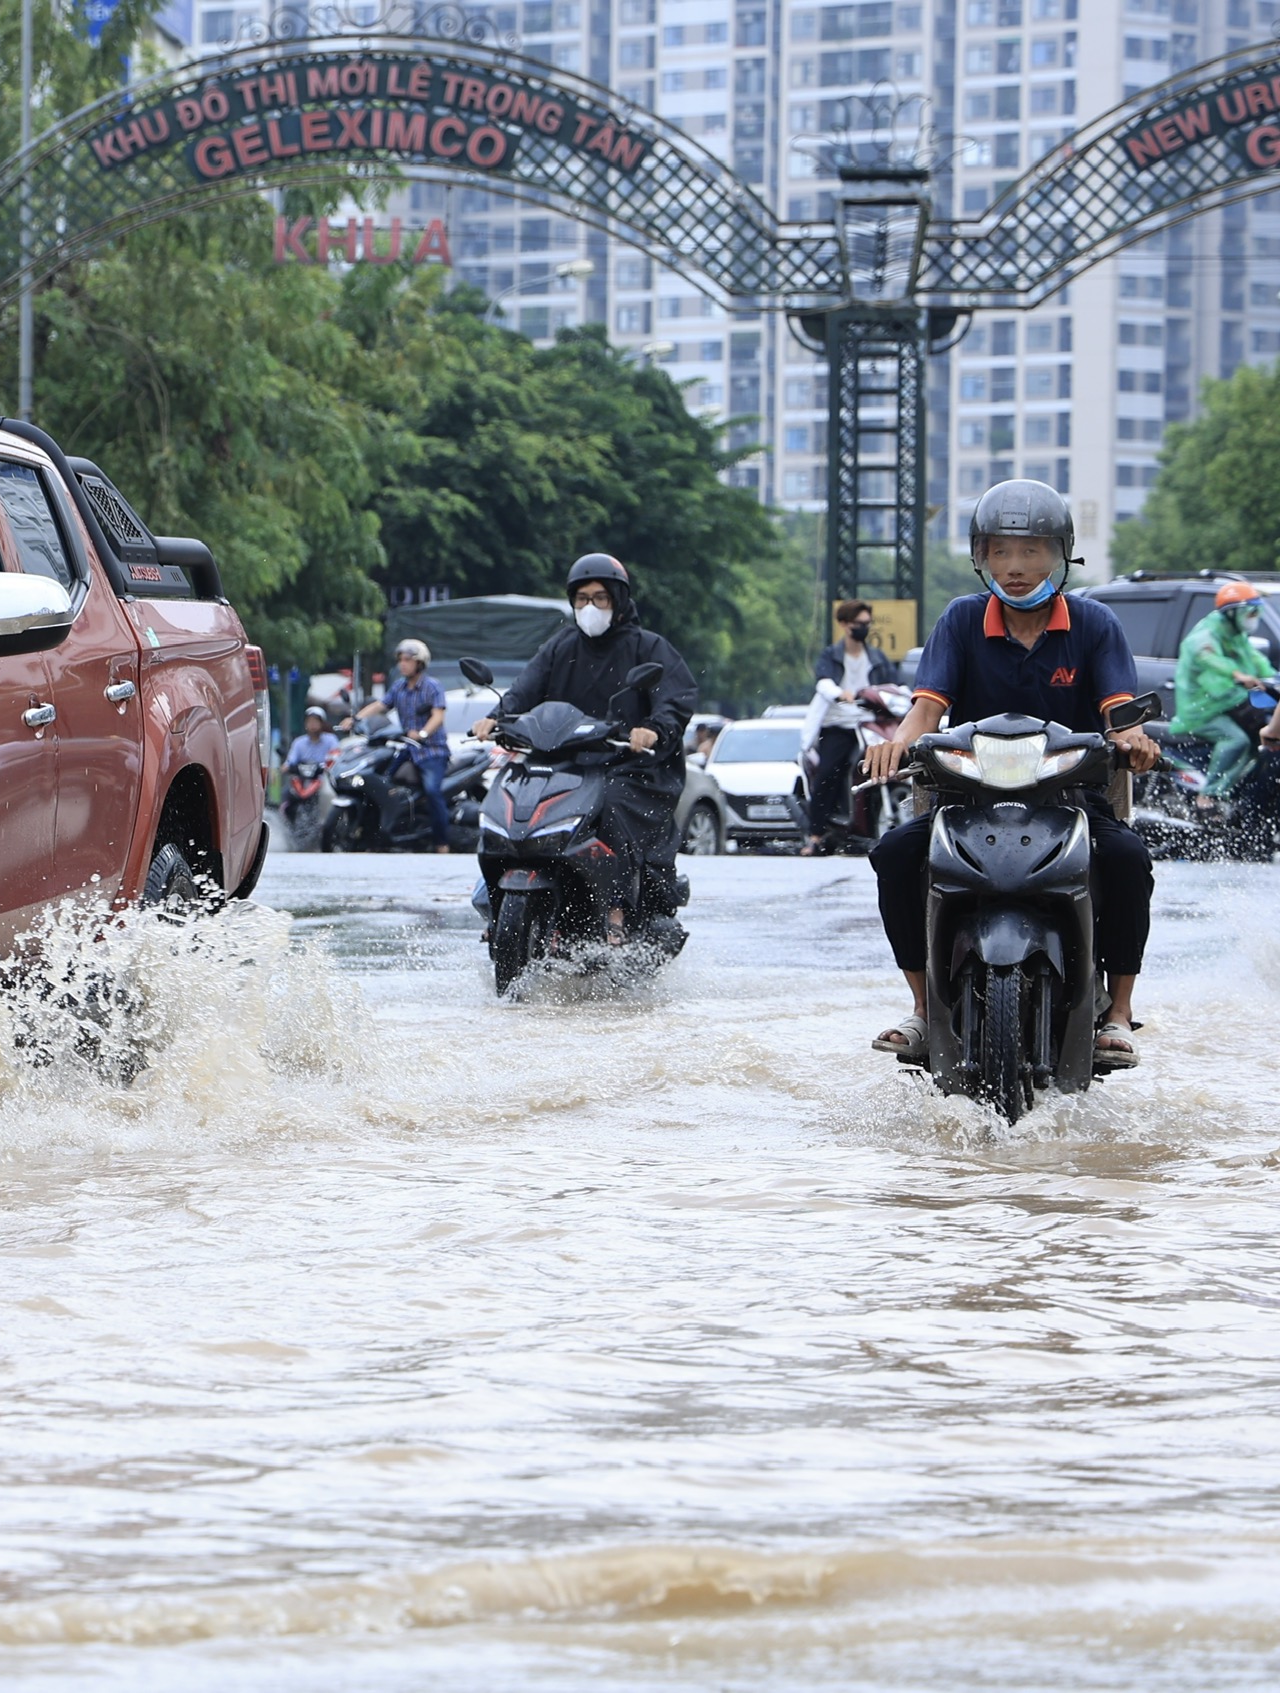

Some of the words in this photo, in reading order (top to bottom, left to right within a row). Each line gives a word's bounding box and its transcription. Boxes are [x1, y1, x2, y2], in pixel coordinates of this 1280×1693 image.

[92, 109, 169, 166] KHU
[175, 84, 229, 131] ĐÔ
[235, 70, 299, 112] THỊ
[307, 58, 380, 98] MỚI
[387, 61, 433, 99] LÊ
[441, 71, 564, 134] TRỌNG
[1126, 102, 1210, 167] NEW
[1216, 75, 1280, 123] UR
[193, 108, 507, 178] GELEXIMCO
[274, 215, 401, 265] KHU
[413, 217, 453, 267] A
[1050, 666, 1077, 684] AV
[992, 801, 1027, 810] HONDA
